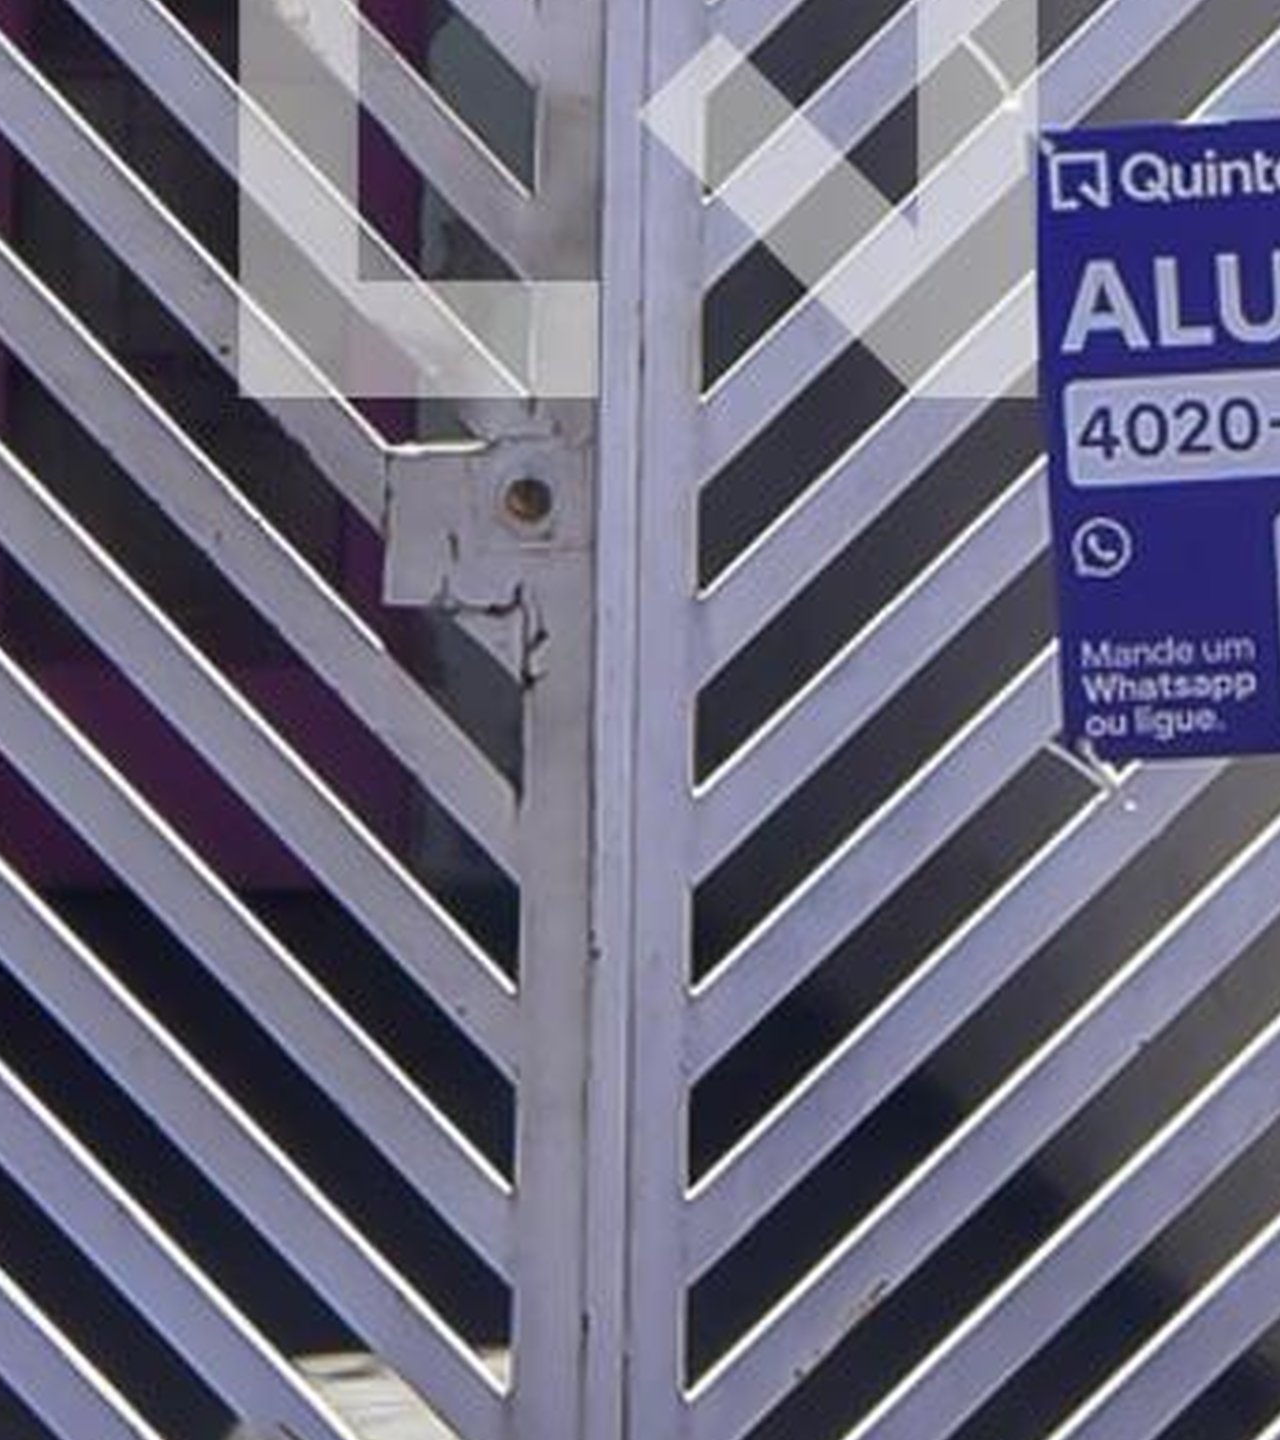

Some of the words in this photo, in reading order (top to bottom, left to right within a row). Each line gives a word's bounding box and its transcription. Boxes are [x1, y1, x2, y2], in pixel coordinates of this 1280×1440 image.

[1080, 636, 1194, 668] Mande
[1201, 637, 1256, 664] um
[1081, 672, 1257, 703] Whatsapp
[1085, 714, 1127, 737] ou
[1133, 705, 1227, 741] ligue.
